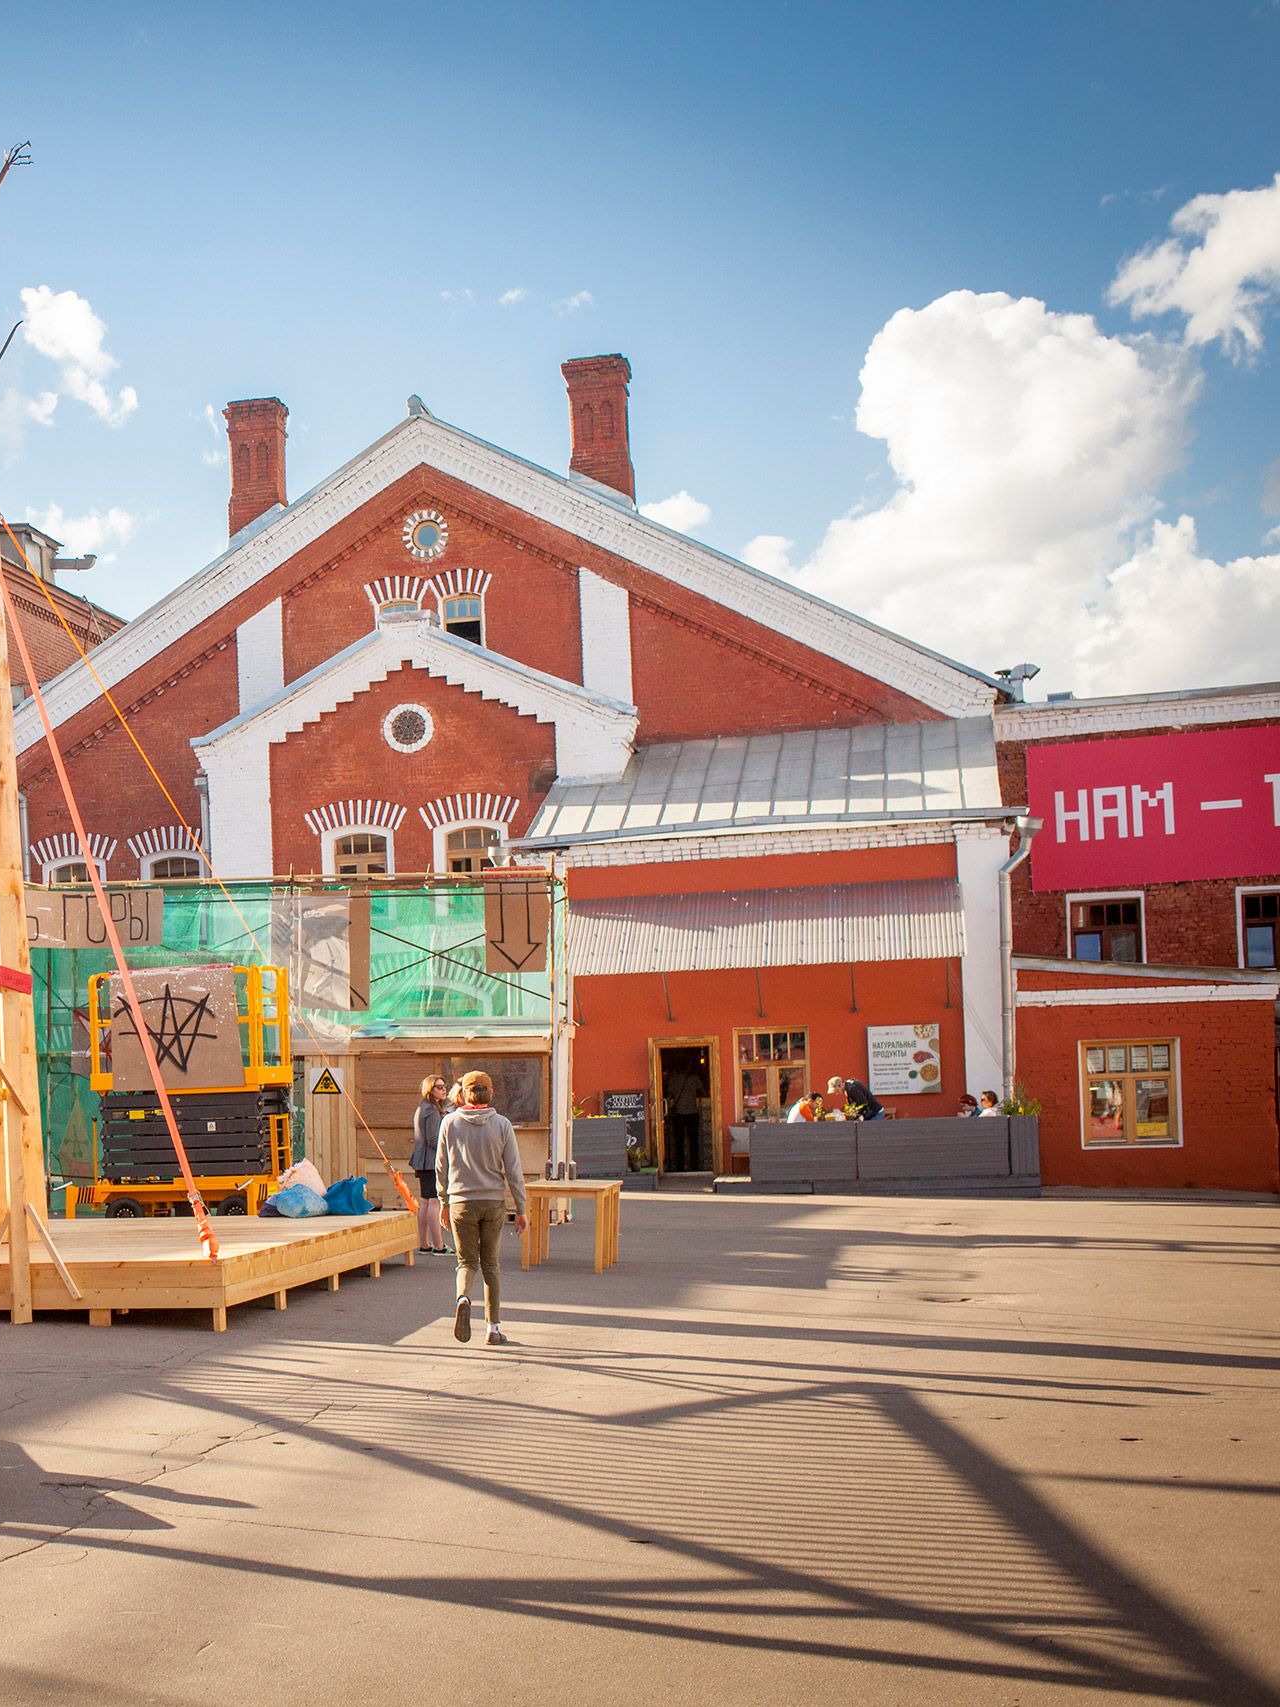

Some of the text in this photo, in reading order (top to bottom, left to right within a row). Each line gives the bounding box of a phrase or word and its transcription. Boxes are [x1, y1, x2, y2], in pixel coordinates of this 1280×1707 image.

[1055, 782, 1175, 843] НАМ
[62, 891, 149, 943] ГОРЫ
[872, 1040, 918, 1049] НАТУРАЛЬНЫЕ
[873, 1050, 907, 1058] ПРОДУКТЫ
